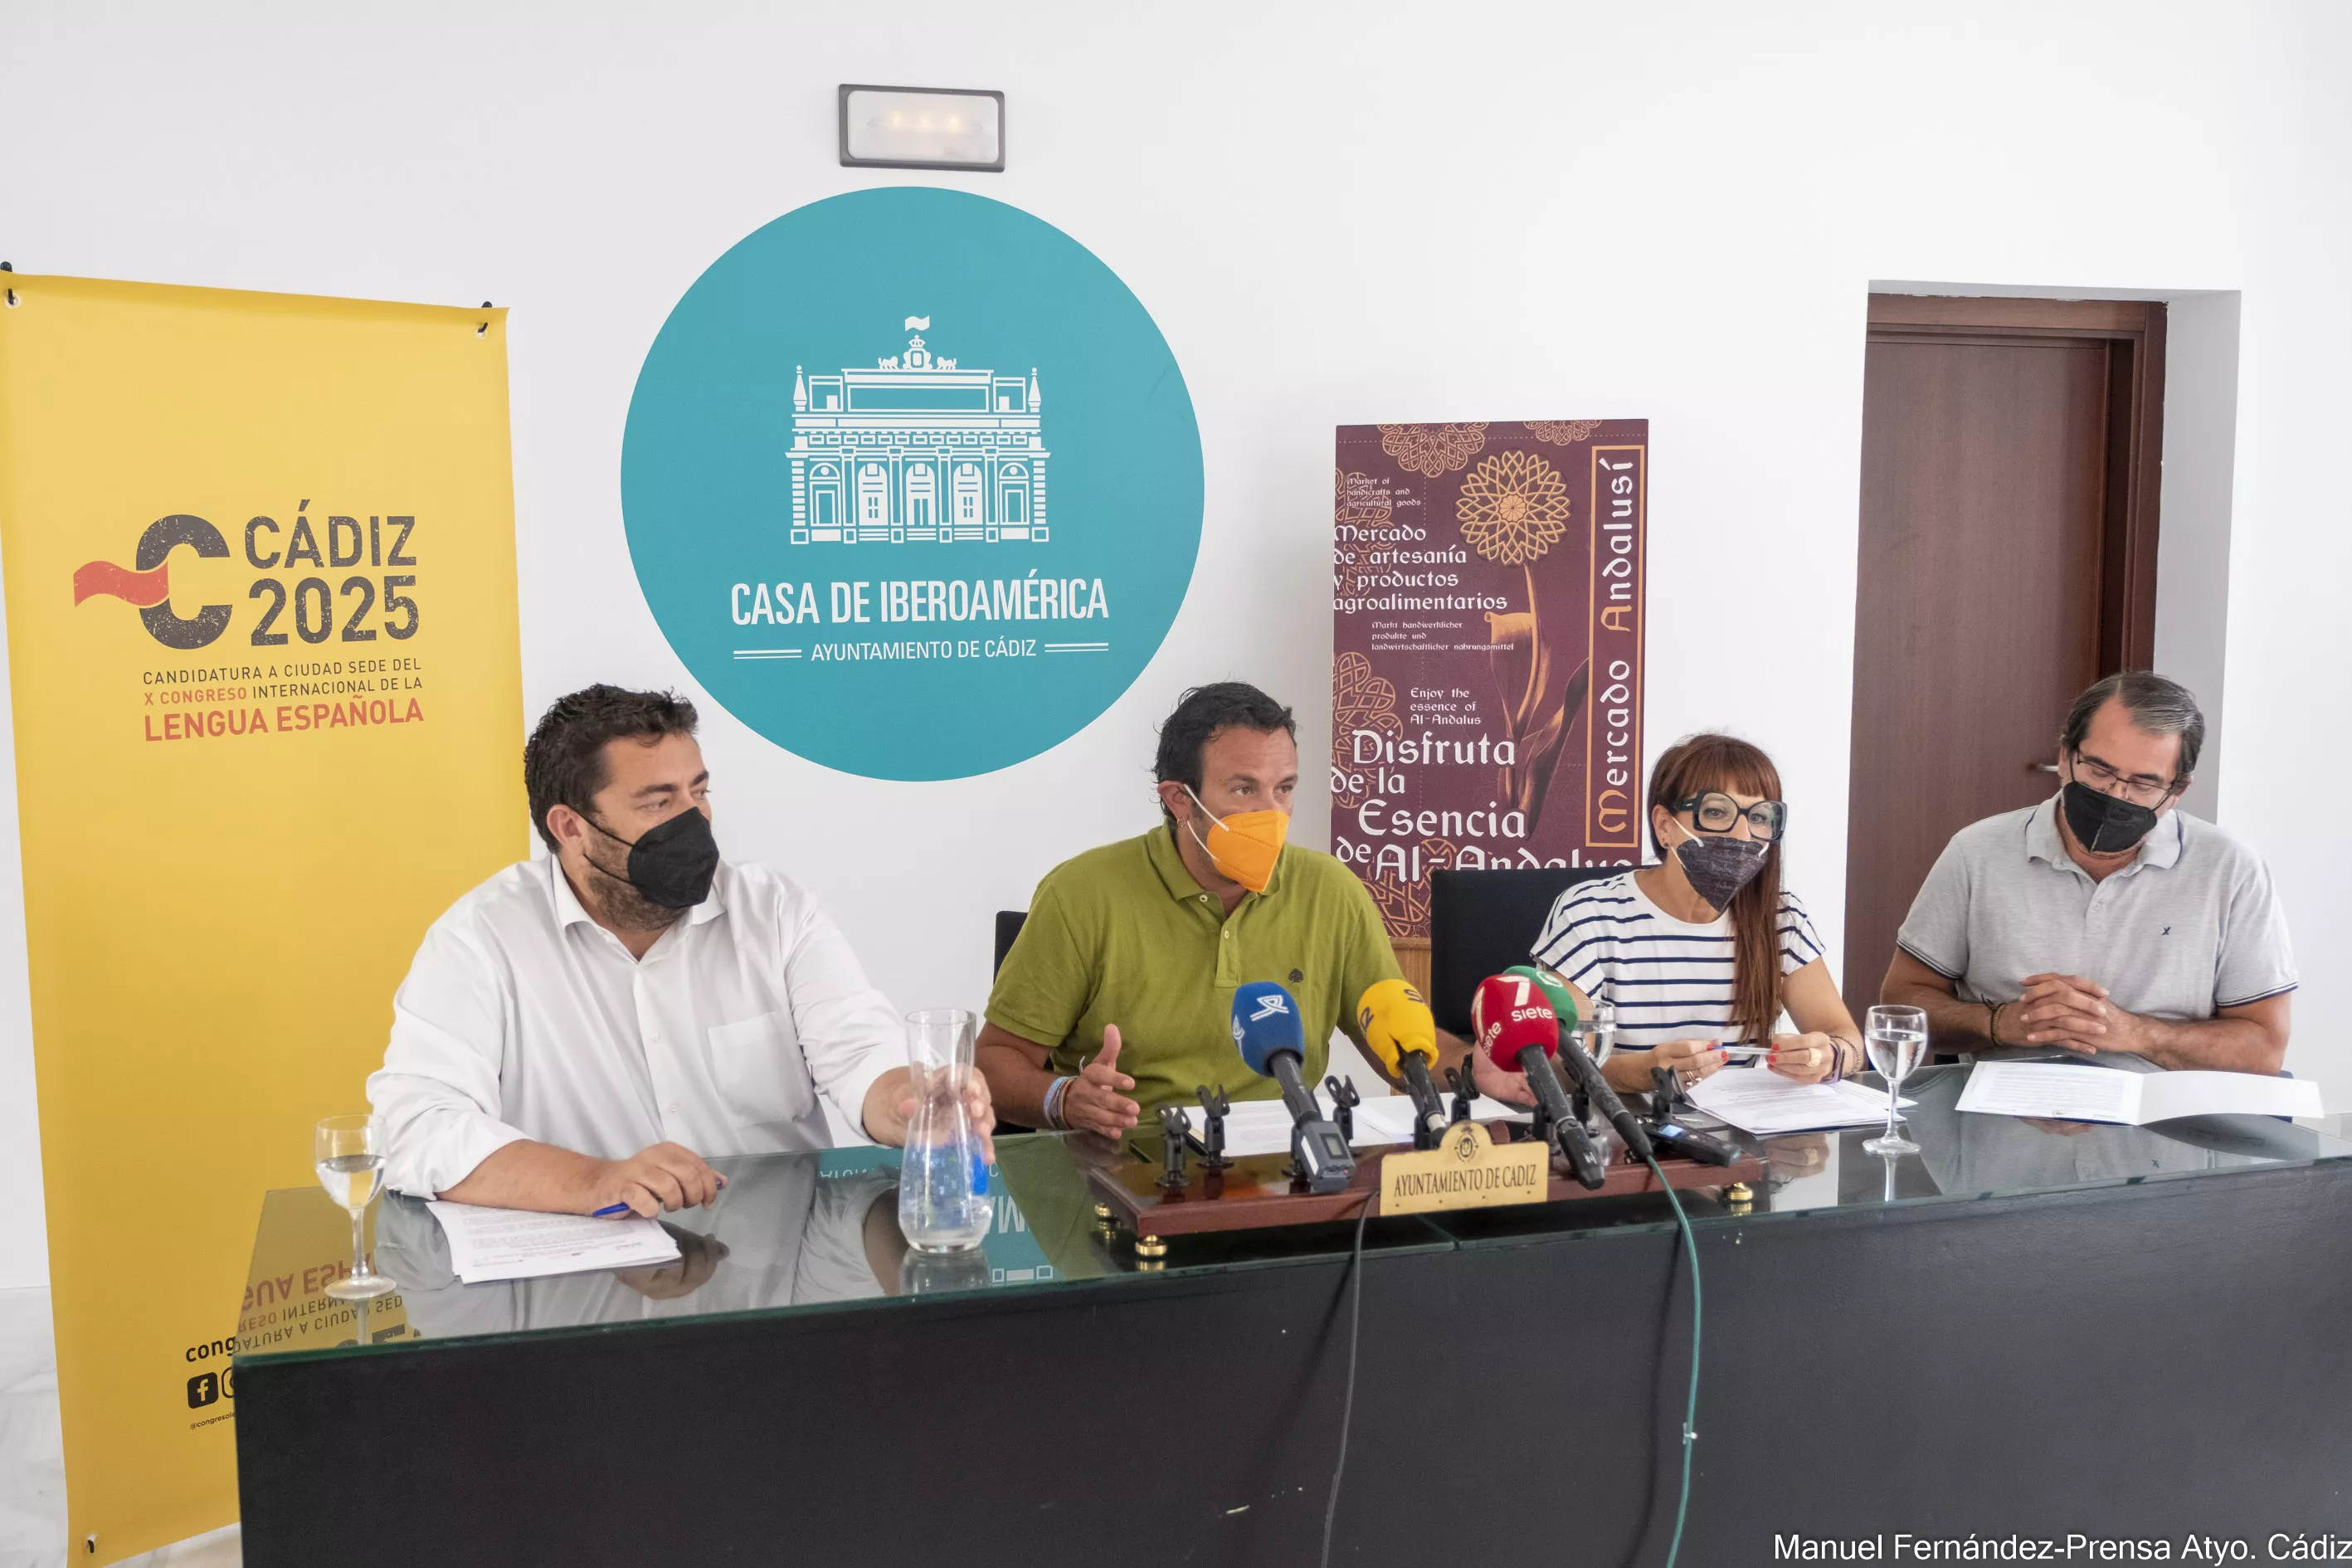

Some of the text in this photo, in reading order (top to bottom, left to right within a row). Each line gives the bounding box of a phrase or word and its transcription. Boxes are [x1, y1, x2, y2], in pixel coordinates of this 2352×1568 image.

[1346, 477, 1390, 485] Market of
[1346, 488, 1390, 496] handicrafts
[1346, 499, 1421, 508] agricultural goods
[245, 499, 417, 569] CÁDIZ
[1334, 523, 1426, 542] Mercado
[1334, 543, 1467, 565] de artesanía
[1333, 570, 1458, 592] y productos
[249, 574, 420, 647] 2025
[731, 568, 1109, 626] CASA DE IBEROAMÉRICA
[1333, 592, 1507, 615] agroalimentarios
[811, 635, 1037, 662] AYUNTAMIENTO DE CÁDIZ
[1371, 632, 1407, 640] produkte
[1454, 643, 1514, 652] nahrungsmittel
[1598, 457, 1634, 833] Mercado Andalusí
[143, 658, 421, 685] CANDIDATURA A CIUDAD SEDE DEL
[144, 676, 423, 706] X CONGRESO INTERNACIONAL DE LA
[1410, 687, 1469, 700] Enjoy the
[144, 694, 425, 742] LENGUA ESPAÑOLA
[1410, 701, 1477, 712] essence of
[1410, 713, 1482, 725] Al-Andalus
[1351, 729, 1516, 766] Disfruta
[1331, 766, 1405, 794] de la
[1358, 798, 1526, 838] Esencia
[1336, 836, 1371, 864] de
[1496, 975, 1531, 1007] 7
[1511, 1006, 1553, 1022] siete
[1394, 1168, 1483, 1197] AYUNTAMIENTO
[1485, 1166, 1500, 1190] DE
